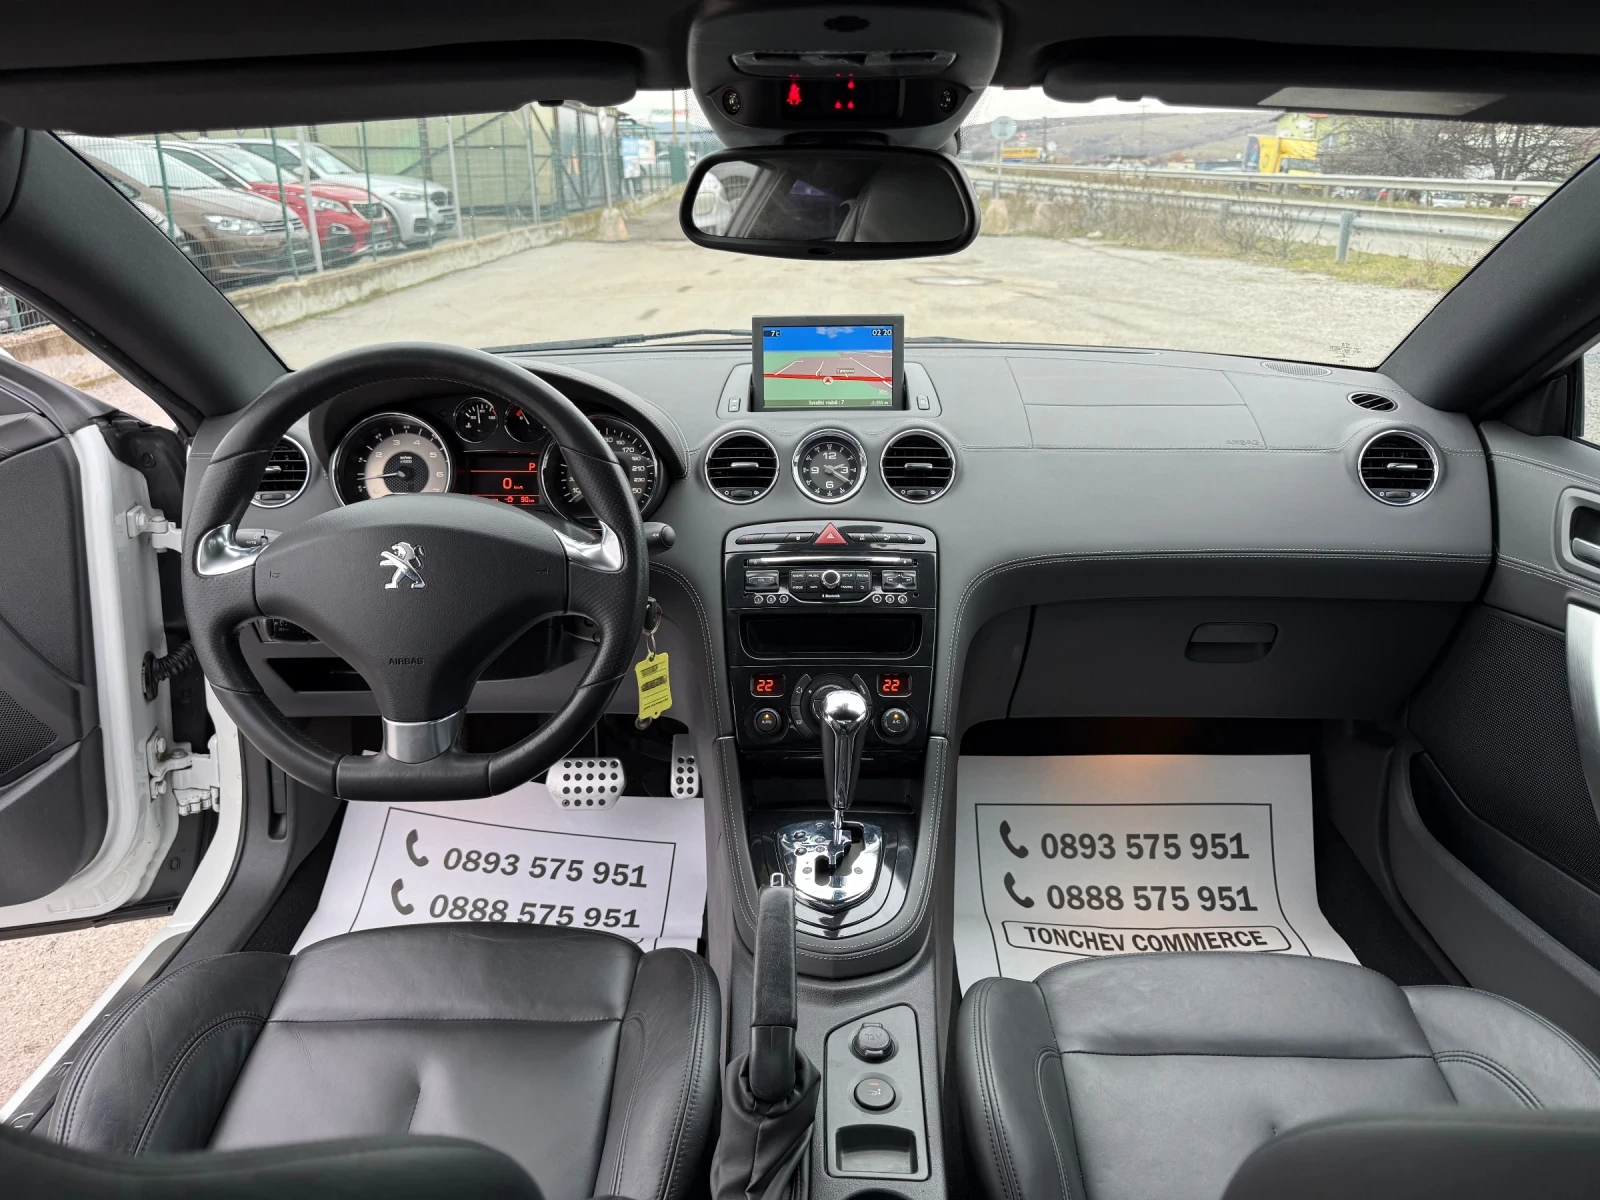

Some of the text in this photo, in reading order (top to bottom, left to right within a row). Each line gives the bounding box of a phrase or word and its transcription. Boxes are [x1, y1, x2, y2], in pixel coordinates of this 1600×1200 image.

[822, 452, 837, 460] 12
[811, 466, 819, 474] 9
[840, 466, 848, 474] 3
[503, 477, 512, 490] 0
[825, 481, 834, 489] 6
[388, 657, 425, 666] AIRBAG
[756, 679, 774, 692] 22
[882, 679, 900, 692] 22
[1041, 832, 1250, 860] 0893 575 951
[443, 847, 648, 889] 0893 575 951
[1047, 884, 1259, 912] 0888 575 951
[429, 894, 641, 929] 0888 575 951
[1024, 926, 1268, 952] TONCHEV COMMERCE
